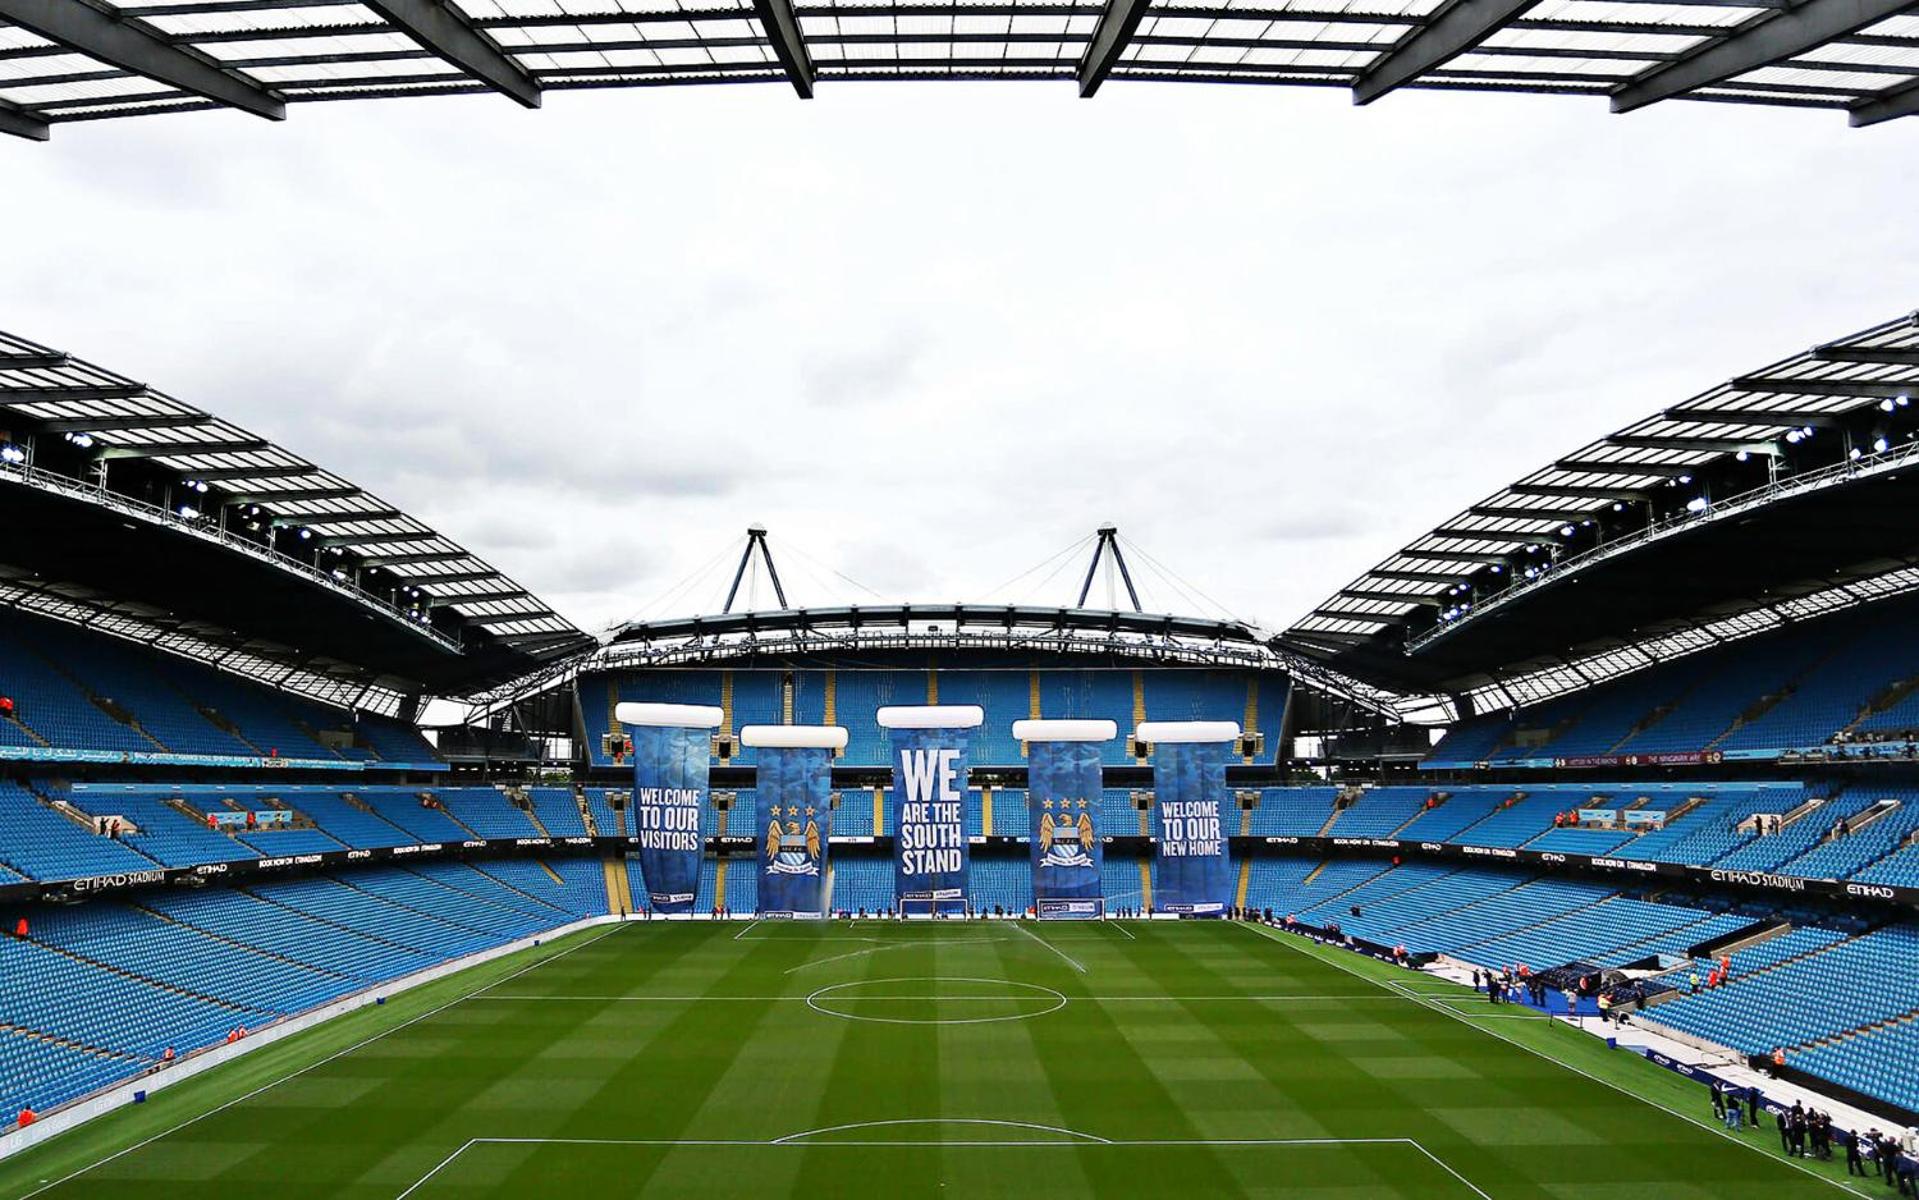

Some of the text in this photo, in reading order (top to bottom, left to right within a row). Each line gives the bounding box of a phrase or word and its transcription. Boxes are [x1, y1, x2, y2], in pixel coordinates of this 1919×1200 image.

[901, 749, 961, 801] WE
[640, 788, 699, 806] WELCOME
[640, 806, 698, 830] TO OUR
[902, 803, 961, 823] ARE THE
[1162, 801, 1219, 818] WELCOME
[902, 824, 961, 849] SOUTH
[1163, 818, 1221, 840] TO OUR
[641, 830, 698, 851] VISITORS
[1163, 841, 1222, 857] NEW HOME
[196, 864, 228, 875] ETIHAD
[902, 849, 962, 875] STAND
[74, 871, 165, 891] ETIHAD STADIUM
[1710, 869, 1805, 890] ETIHAD STADIUM
[1847, 884, 1894, 899] ETIHAD
